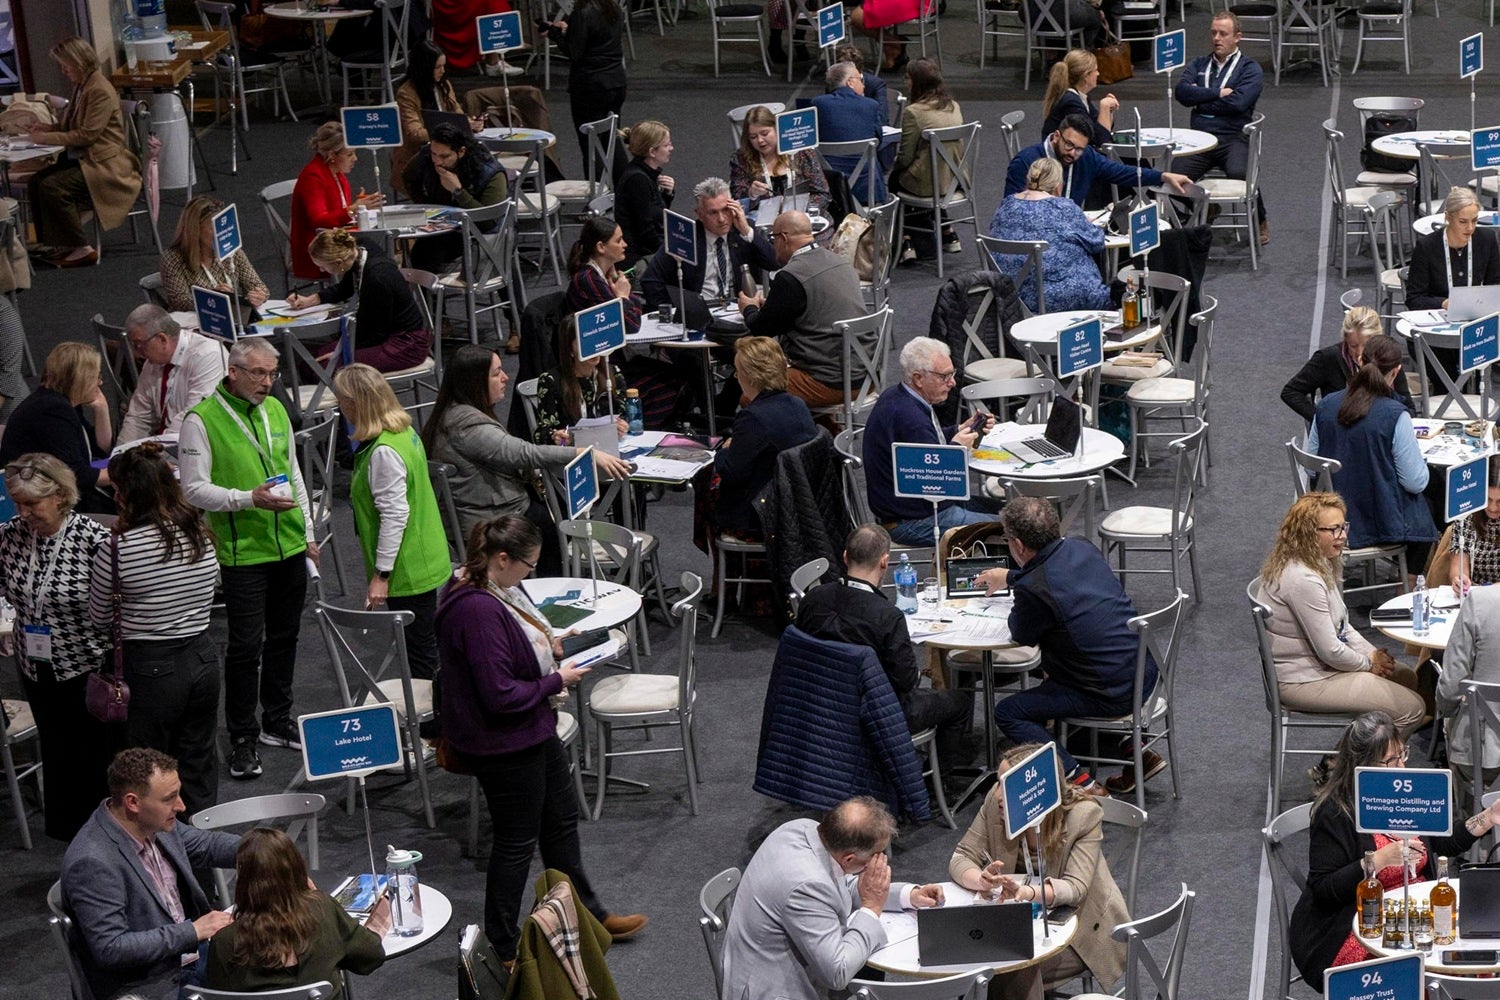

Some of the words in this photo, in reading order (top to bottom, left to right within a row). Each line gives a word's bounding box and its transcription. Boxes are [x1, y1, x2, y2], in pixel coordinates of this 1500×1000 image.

[493, 19, 503, 28] 57
[1166, 39, 1173, 47] 79
[366, 113, 379, 122] 58
[793, 116, 802, 126] 77
[1488, 132, 1499, 141] 99
[1140, 214, 1146, 225] 81
[594, 312, 606, 324] 75
[583, 329, 598, 338] Limerick
[598, 325, 610, 333] Strand
[1074, 330, 1085, 342] 82
[1475, 326, 1484, 338] 97
[924, 454, 940, 465] 83
[575, 465, 582, 478] 74
[1462, 469, 1471, 481] 96
[341, 719, 361, 733] 73
[335, 737, 352, 746] Lake
[353, 734, 372, 743] Hotel
[1025, 766, 1037, 783] 84
[1019, 783, 1037, 800] Muckross
[1038, 778, 1046, 788] Park
[1393, 779, 1413, 793] 95
[1022, 792, 1033, 805] Hotel
[1037, 788, 1045, 796] Spa
[1362, 797, 1399, 805] Portmagee
[1401, 797, 1430, 806] Distilling
[1366, 804, 1394, 813] Brewing
[1395, 806, 1427, 814] Company
[1362, 972, 1383, 988] 94
[1376, 989, 1393, 998] Trust
